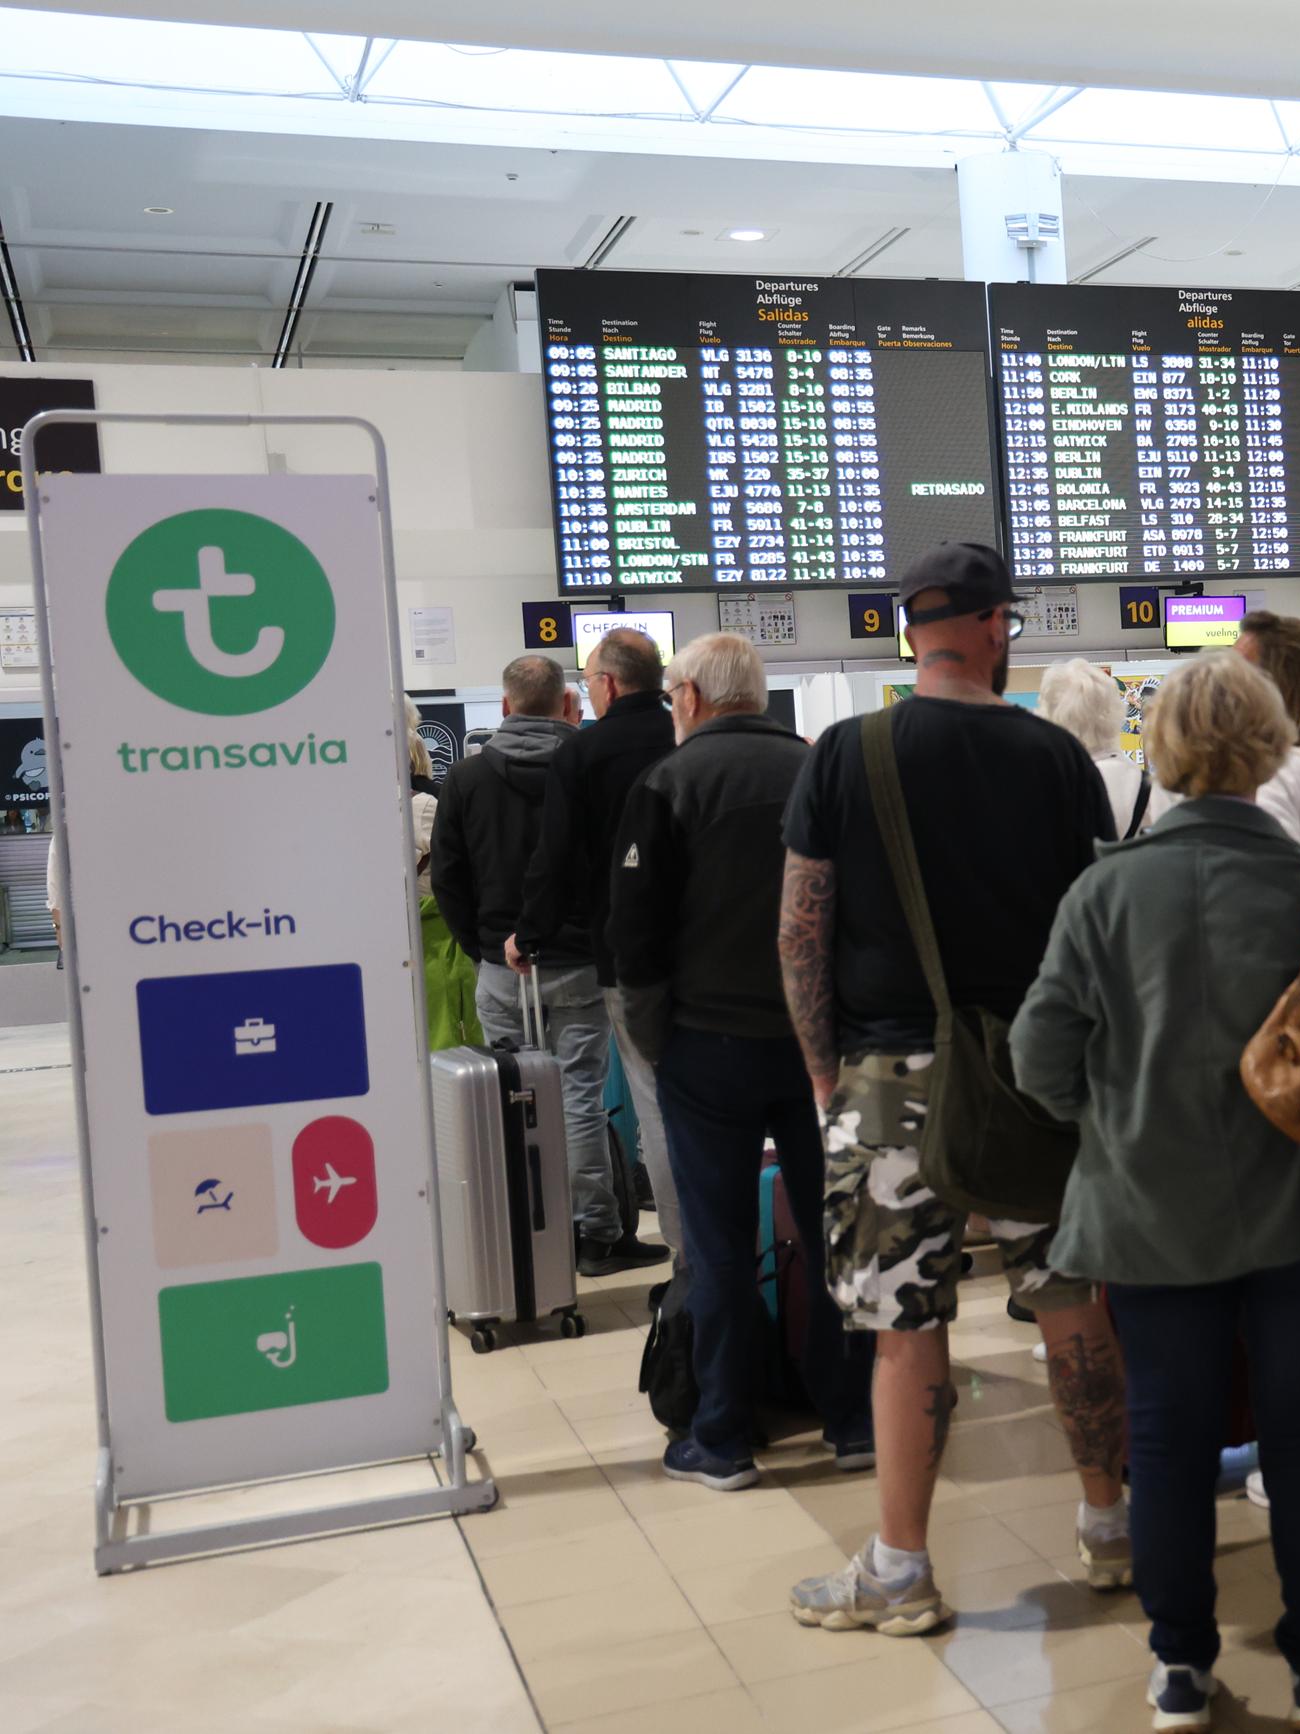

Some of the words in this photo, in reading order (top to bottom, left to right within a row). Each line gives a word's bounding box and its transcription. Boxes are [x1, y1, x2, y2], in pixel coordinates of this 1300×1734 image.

[756, 280, 819, 293] Departures
[756, 294, 802, 307] Abflüge
[1178, 290, 1233, 301] Departures
[1178, 303, 1218, 314] Abflüge
[758, 309, 809, 321] Salidas
[829, 324, 856, 332] Boarding
[549, 334, 569, 342] Hora
[603, 335, 633, 343] Destino
[700, 336, 721, 344] Vuelo
[829, 331, 850, 339] Abflug
[829, 339, 866, 347] Embarque
[903, 340, 952, 348] Observaciones
[604, 348, 676, 360] SANTIAGO
[1049, 356, 1125, 367] LONDON/LTN
[606, 366, 687, 377] SANTANDER
[1050, 372, 1080, 382] CORK
[607, 383, 660, 394] BILBAO
[1051, 388, 1097, 398] BERLIN
[608, 400, 661, 412] MADRID
[1052, 404, 1128, 415] E.MIDLANDS
[609, 418, 663, 429] MADRID
[1053, 420, 1122, 430] EINDHOVEN
[611, 435, 664, 446] MADRID
[1054, 436, 1107, 446] GATWICK
[612, 452, 665, 463] MADRID
[1055, 452, 1100, 462] BERLIN
[614, 470, 667, 481] ZURICH
[1056, 468, 1101, 478] DUBLIN
[614, 487, 668, 498] NANTES
[911, 483, 985, 496] RETRASADO
[1057, 484, 1110, 494] BOLONIA
[616, 503, 696, 515] AMSTERDAM
[1058, 499, 1126, 510] BARCELONA
[1058, 515, 1110, 526] BELFAST
[617, 521, 670, 532] DUBLIN
[1059, 531, 1127, 542] FRANKFURT
[618, 538, 680, 549] BRISTOL
[1060, 547, 1128, 558] FRANKFURT
[620, 554, 708, 567] LONDON/STN
[1061, 562, 1128, 574] FRANKFURT
[621, 572, 682, 584] GATWICK
[1127, 601, 1153, 623] 10
[1171, 605, 1224, 615] PREMIUM
[863, 609, 880, 632] 9
[539, 617, 557, 642] 8
[1206, 628, 1238, 639] vueling
[117, 733, 347, 773] transavia
[129, 909, 297, 945] Check-in
